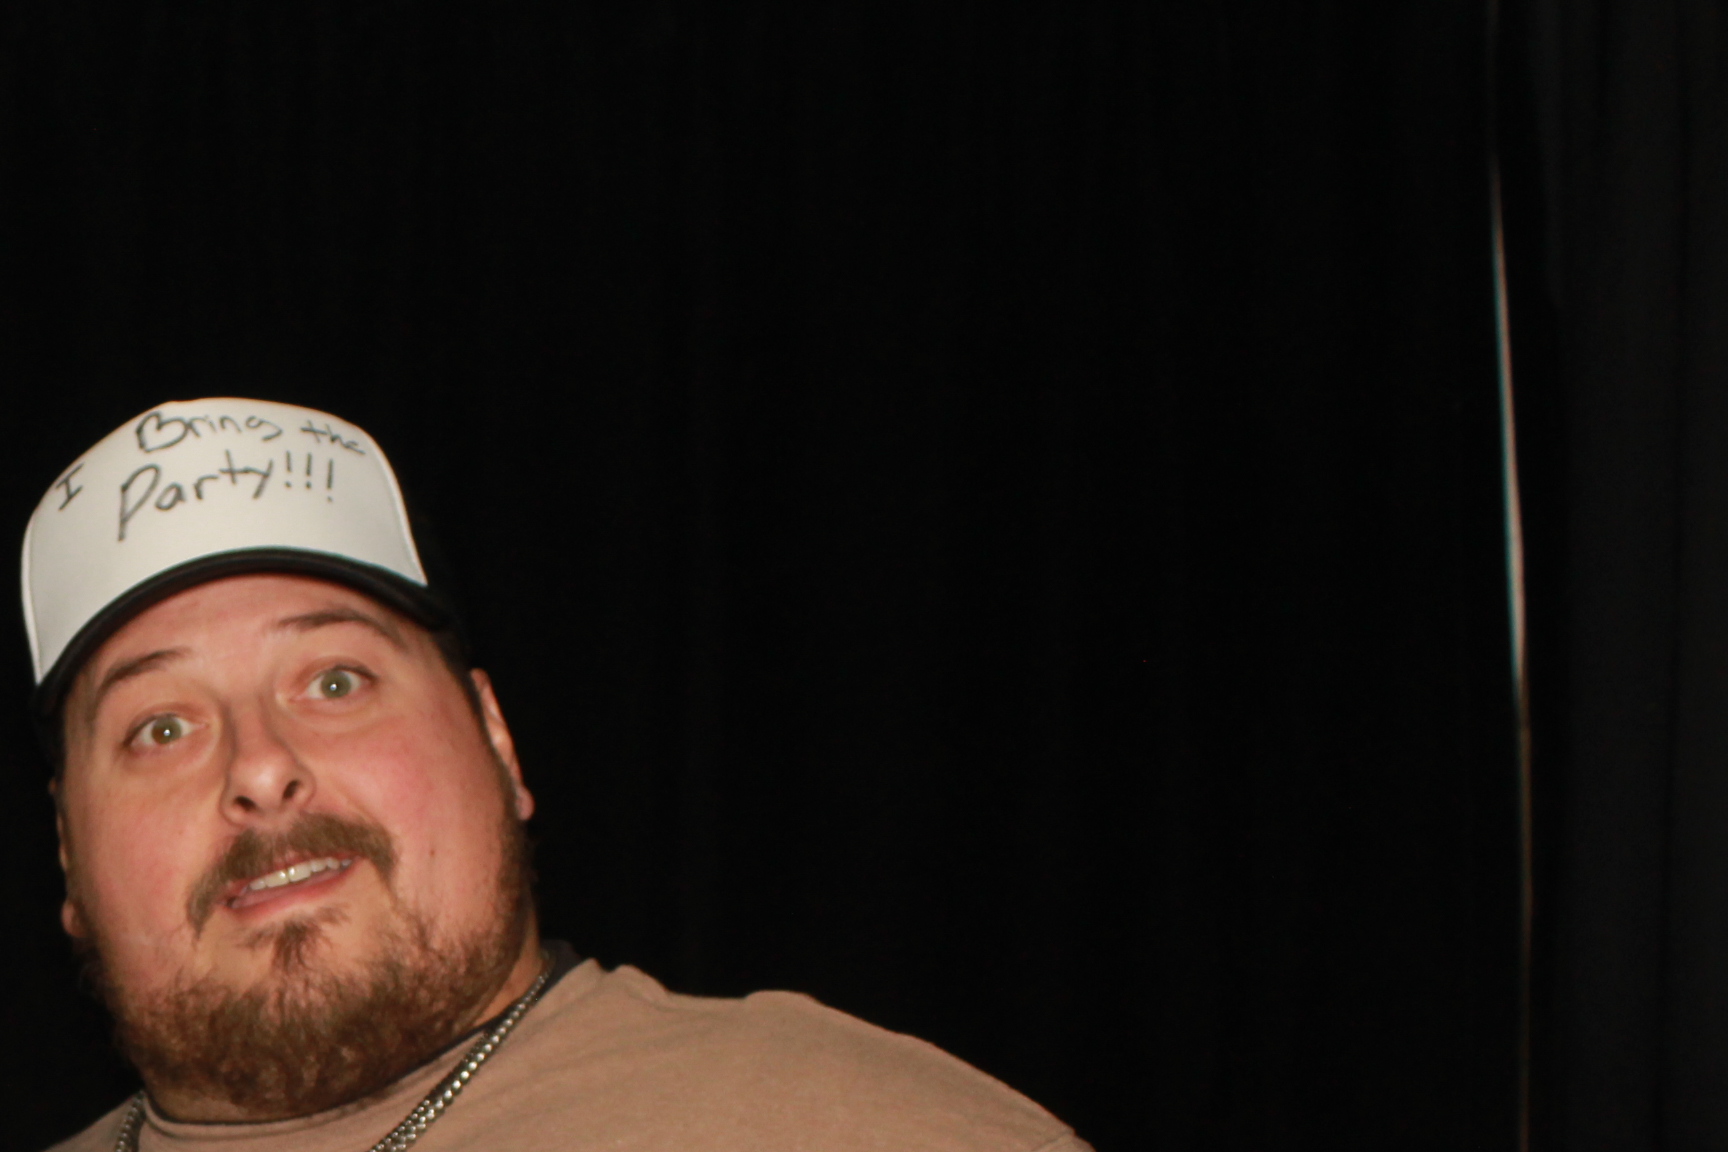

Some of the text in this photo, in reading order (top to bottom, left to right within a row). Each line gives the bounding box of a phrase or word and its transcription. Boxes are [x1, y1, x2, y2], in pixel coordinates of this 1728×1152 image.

[55, 462, 86, 511] I
[300, 420, 366, 455] the
[118, 449, 335, 542] Party!!!
